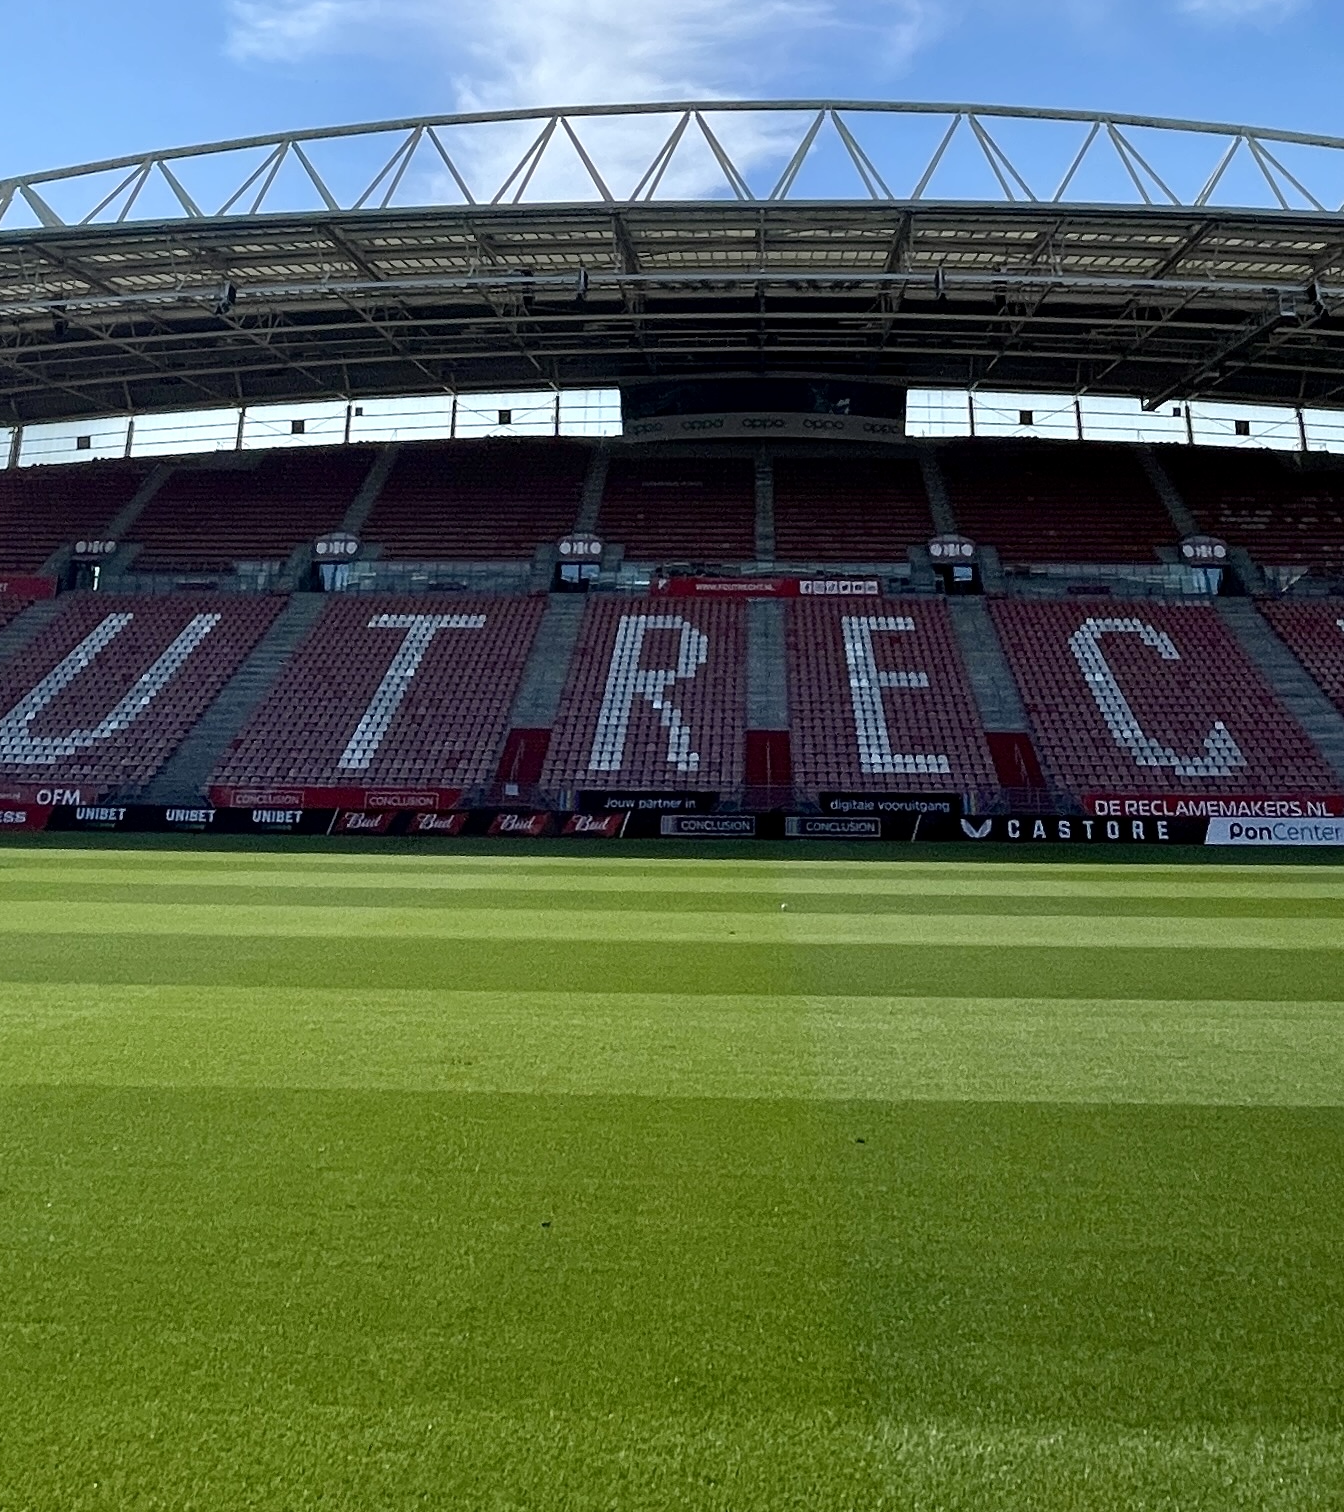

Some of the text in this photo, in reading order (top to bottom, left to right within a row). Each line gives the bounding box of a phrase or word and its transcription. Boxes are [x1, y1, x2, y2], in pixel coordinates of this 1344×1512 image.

[235, 792, 434, 807] CONCLUSION CONCLUSION
[604, 797, 696, 810] Jouw partner in
[829, 798, 950, 813] digitale vooruitgang
[1094, 799, 1335, 817] DE RECLAMEMAKERS.NL
[76, 807, 303, 824] UNIBET UNIBET UNIBET
[345, 812, 609, 831] Bud Bud Bud Bud
[680, 820, 875, 832] CONCLUSION CONCLUSION
[1007, 819, 1170, 840] CASTORE
[1228, 822, 1341, 841] PonCenter
